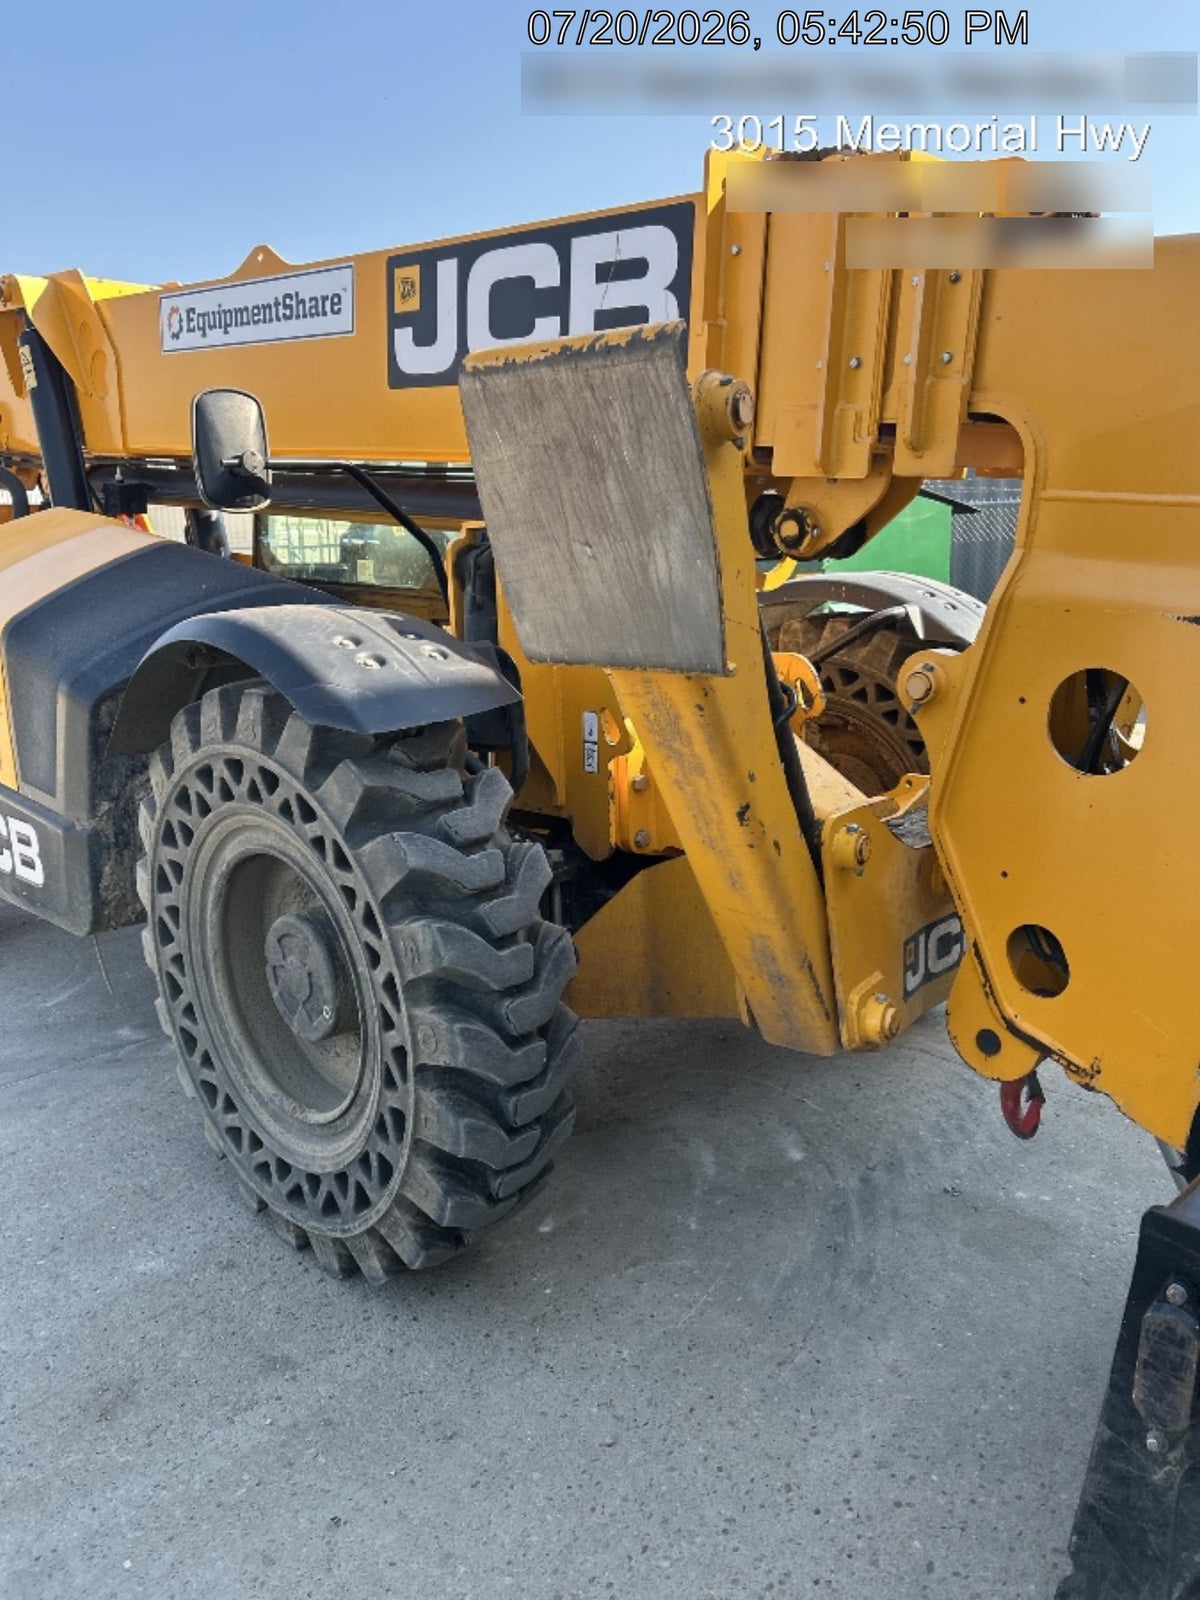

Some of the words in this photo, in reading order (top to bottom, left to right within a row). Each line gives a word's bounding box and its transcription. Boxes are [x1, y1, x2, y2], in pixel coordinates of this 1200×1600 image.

[185, 290, 342, 338] EquipmentShare
[393, 225, 680, 374] JCB
[905, 918, 967, 992] JC
